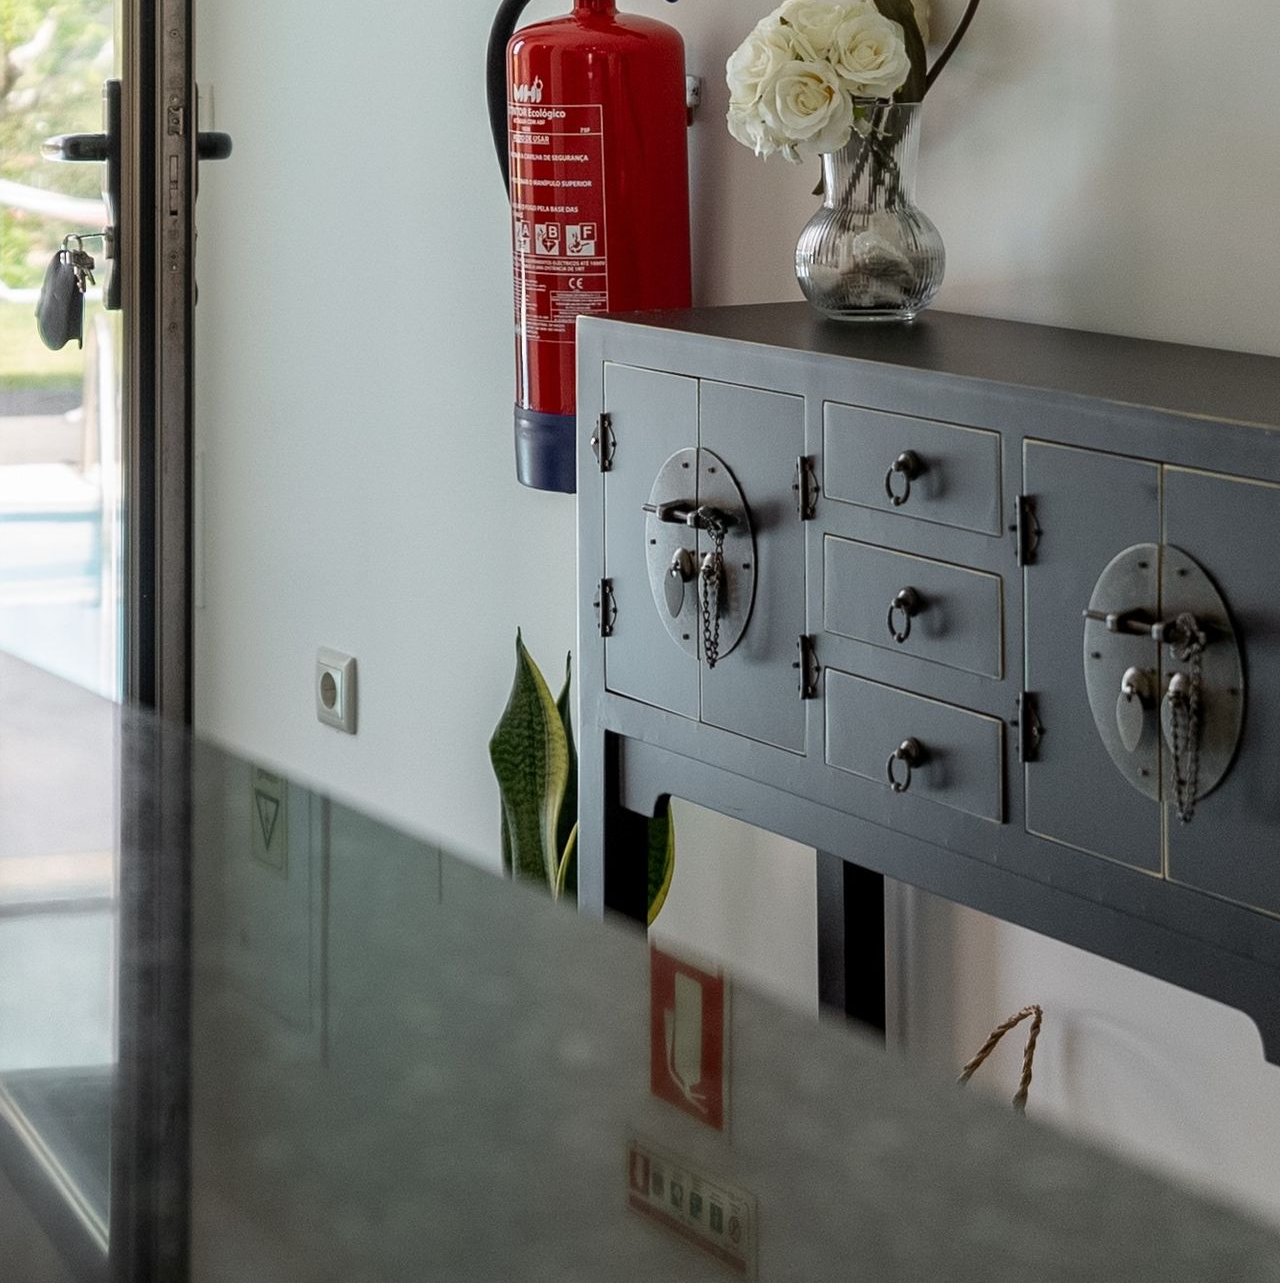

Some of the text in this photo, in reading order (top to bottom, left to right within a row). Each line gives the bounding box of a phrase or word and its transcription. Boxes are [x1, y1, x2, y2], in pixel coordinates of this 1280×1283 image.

[528, 108, 566, 120] Ecológico
[532, 135, 549, 143] USAR
[552, 155, 589, 163] SEGURANÇA
[550, 205, 564, 213] BASE
[522, 223, 529, 237] A
[548, 226, 558, 238] B
[583, 226, 592, 238] F
[568, 277, 584, 289] CE
